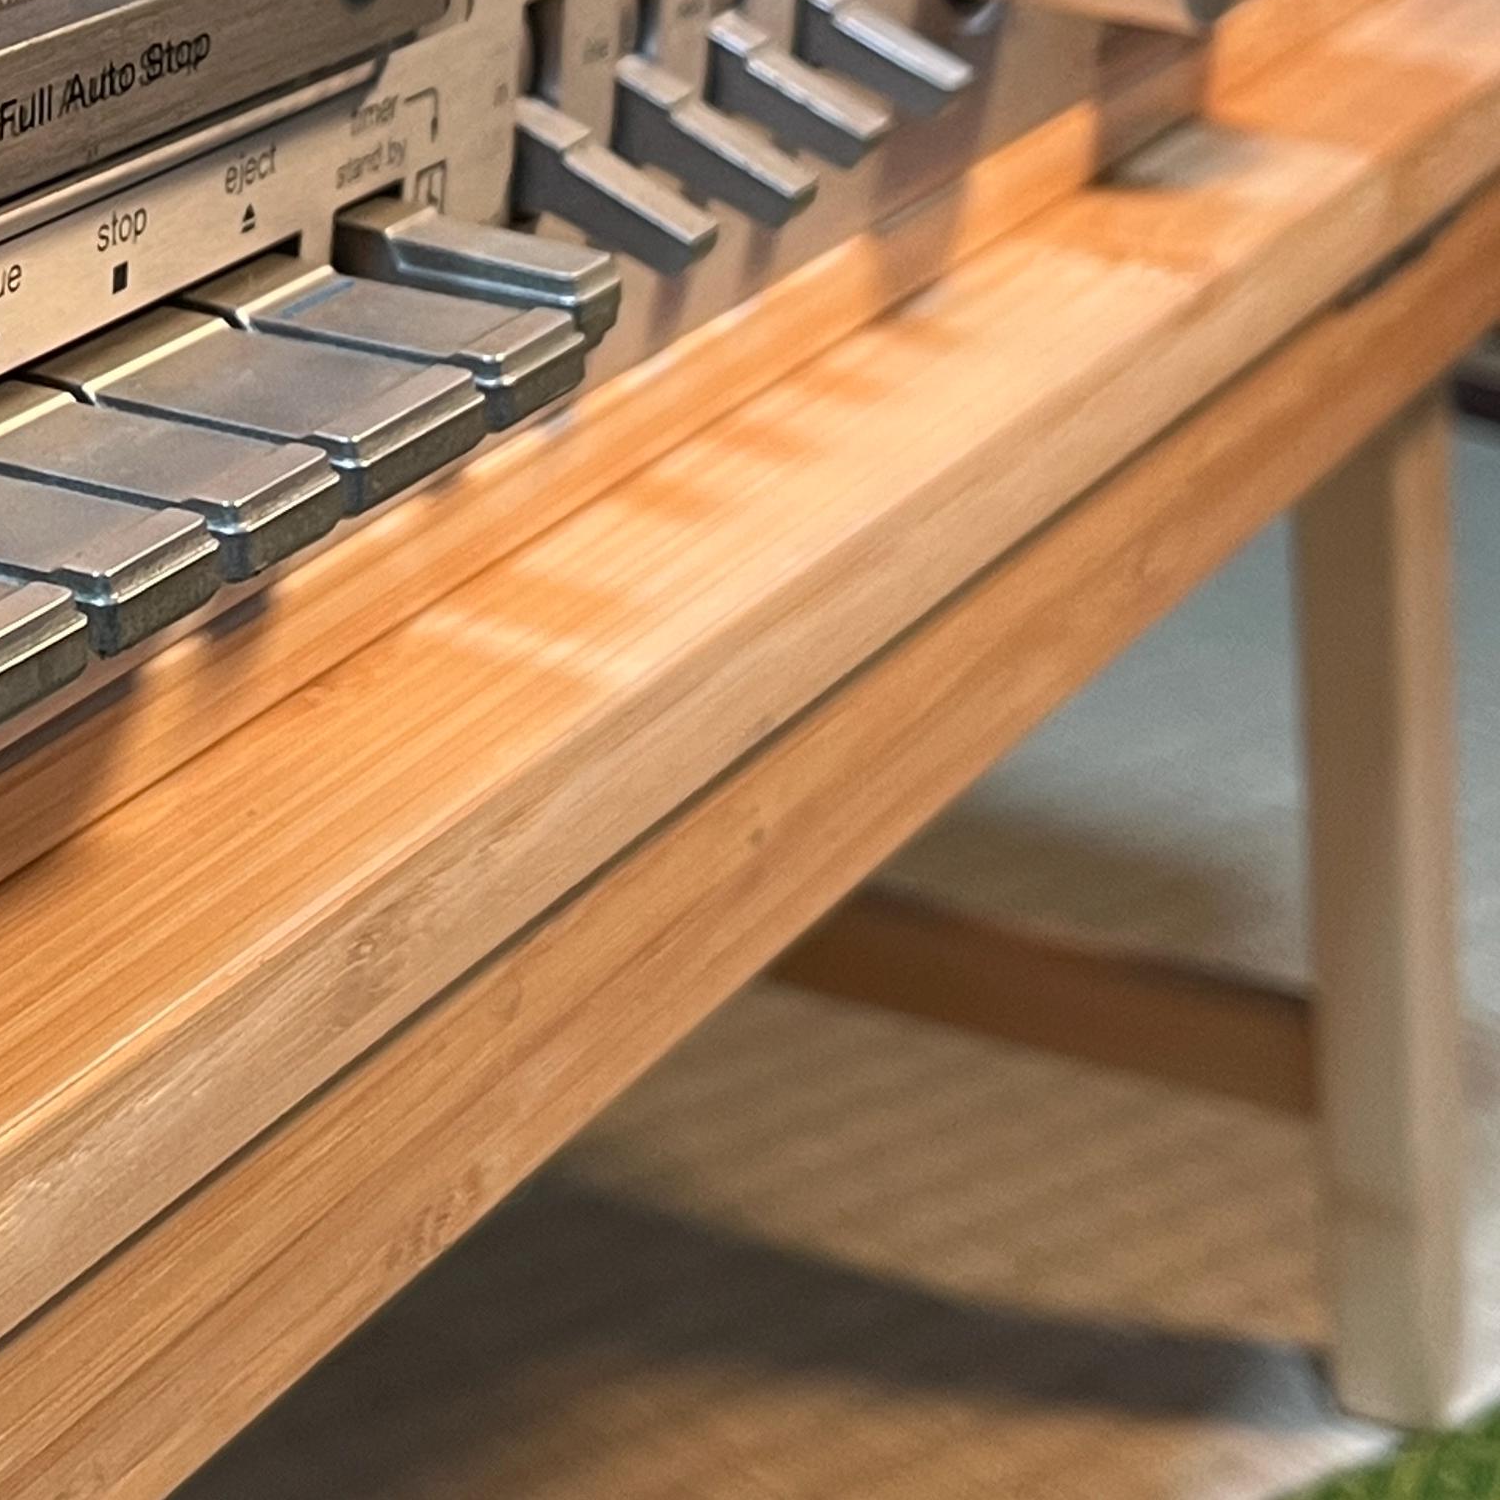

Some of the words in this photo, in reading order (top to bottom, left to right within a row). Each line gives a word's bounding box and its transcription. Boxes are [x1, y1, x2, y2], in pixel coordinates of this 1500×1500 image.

[61, 61, 136, 116] Auto
[140, 32, 211, 86] Stop
[225, 144, 277, 195] eject
[97, 207, 147, 253] stop
